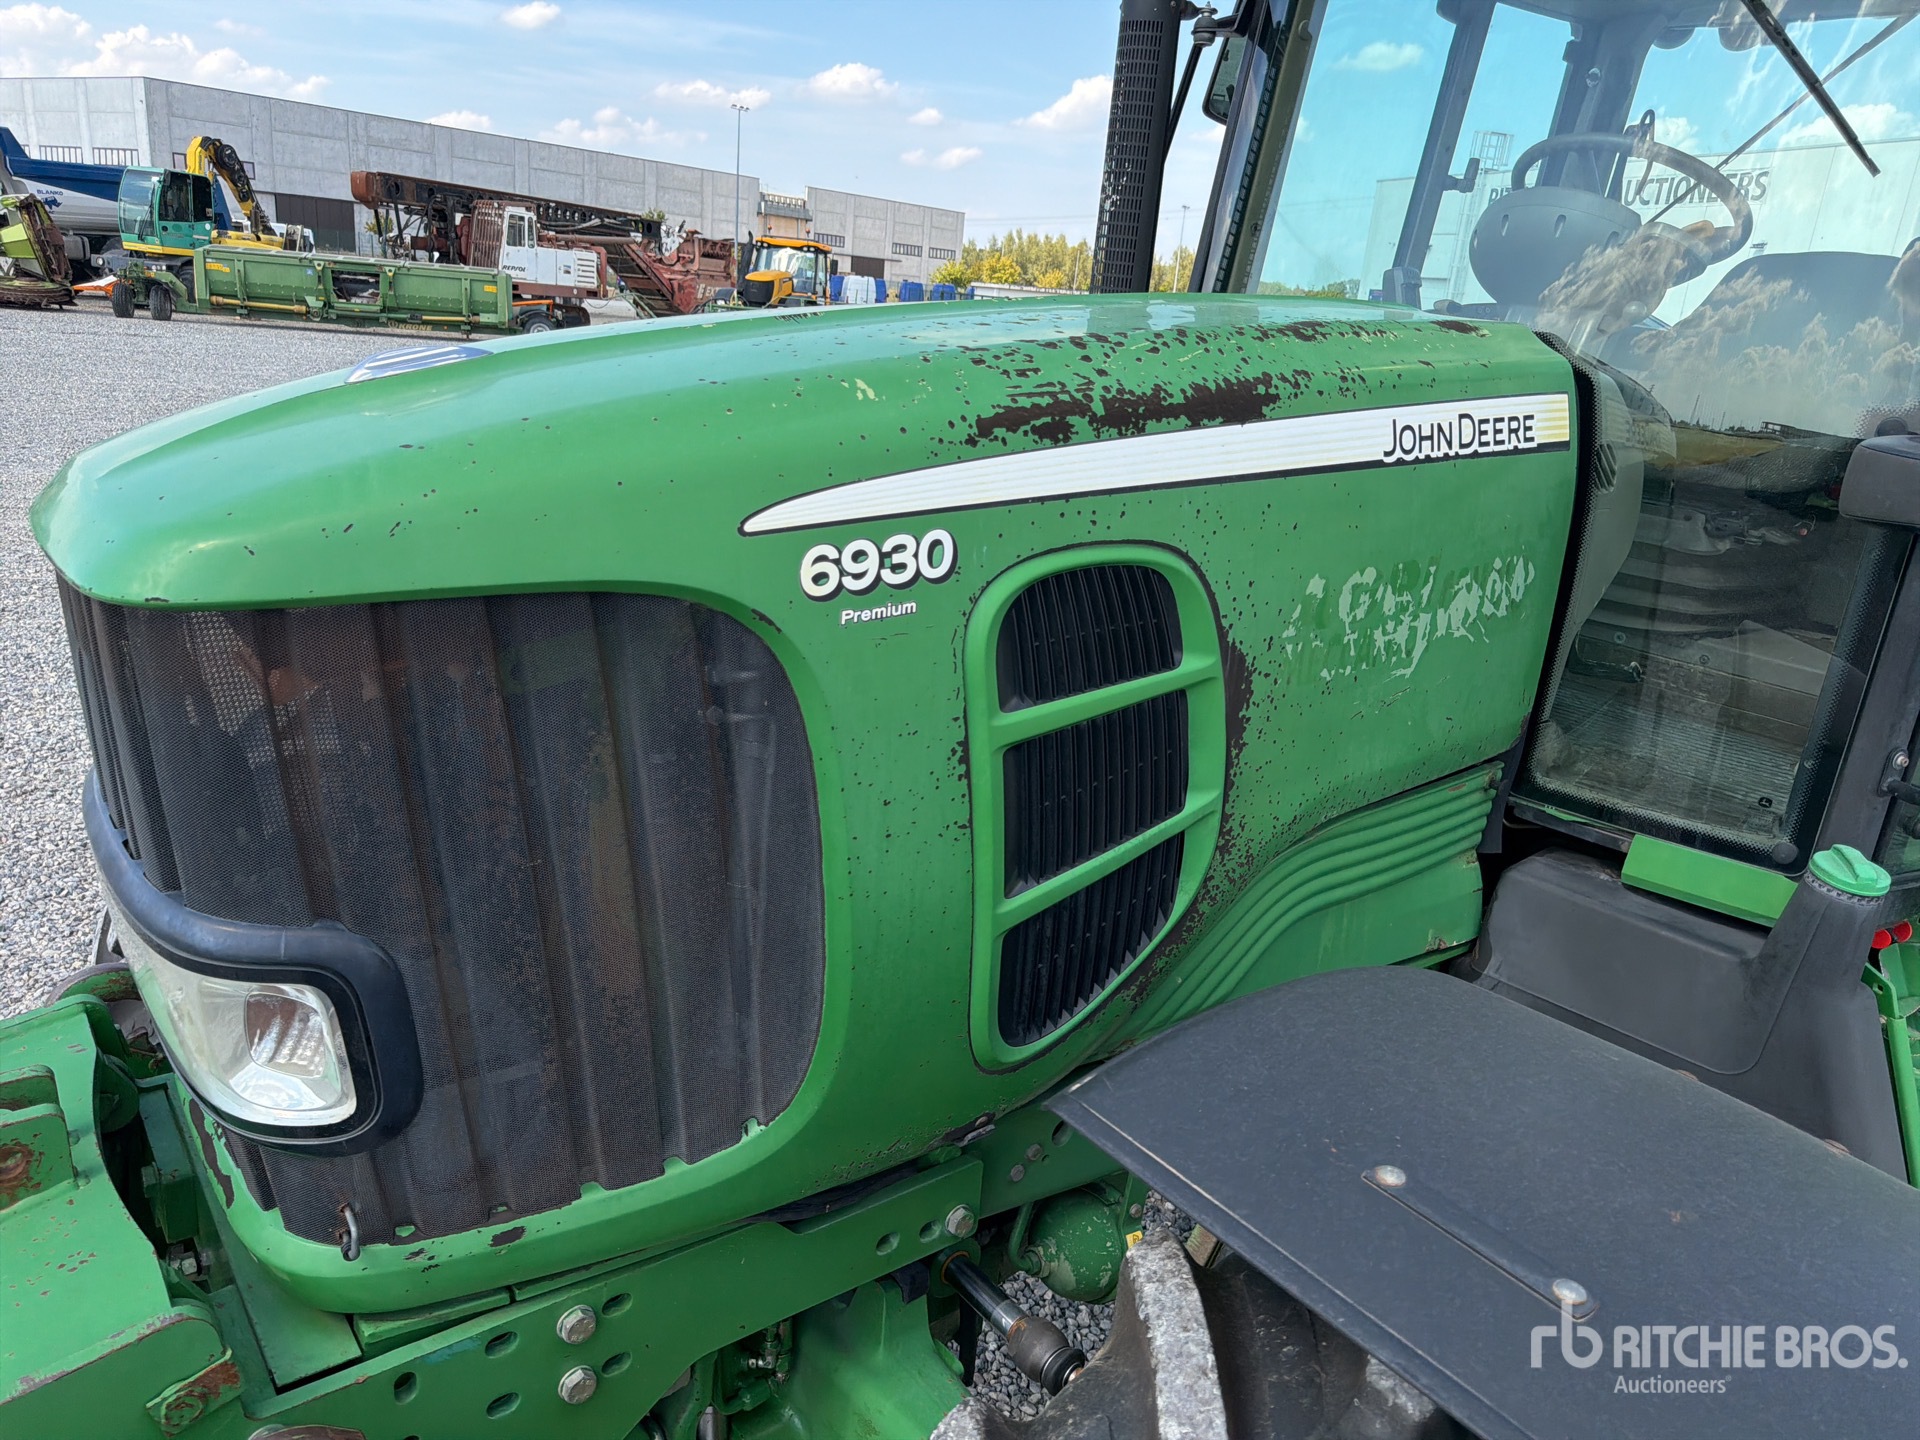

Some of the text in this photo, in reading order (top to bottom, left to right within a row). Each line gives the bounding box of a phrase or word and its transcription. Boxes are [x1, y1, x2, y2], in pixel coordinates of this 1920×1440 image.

[502, 264, 526, 272] REPSOL
[399, 323, 433, 331] KRONE
[1383, 412, 1536, 458] JOHN DEERE
[800, 528, 958, 602] 6930
[841, 601, 917, 625] Premium
